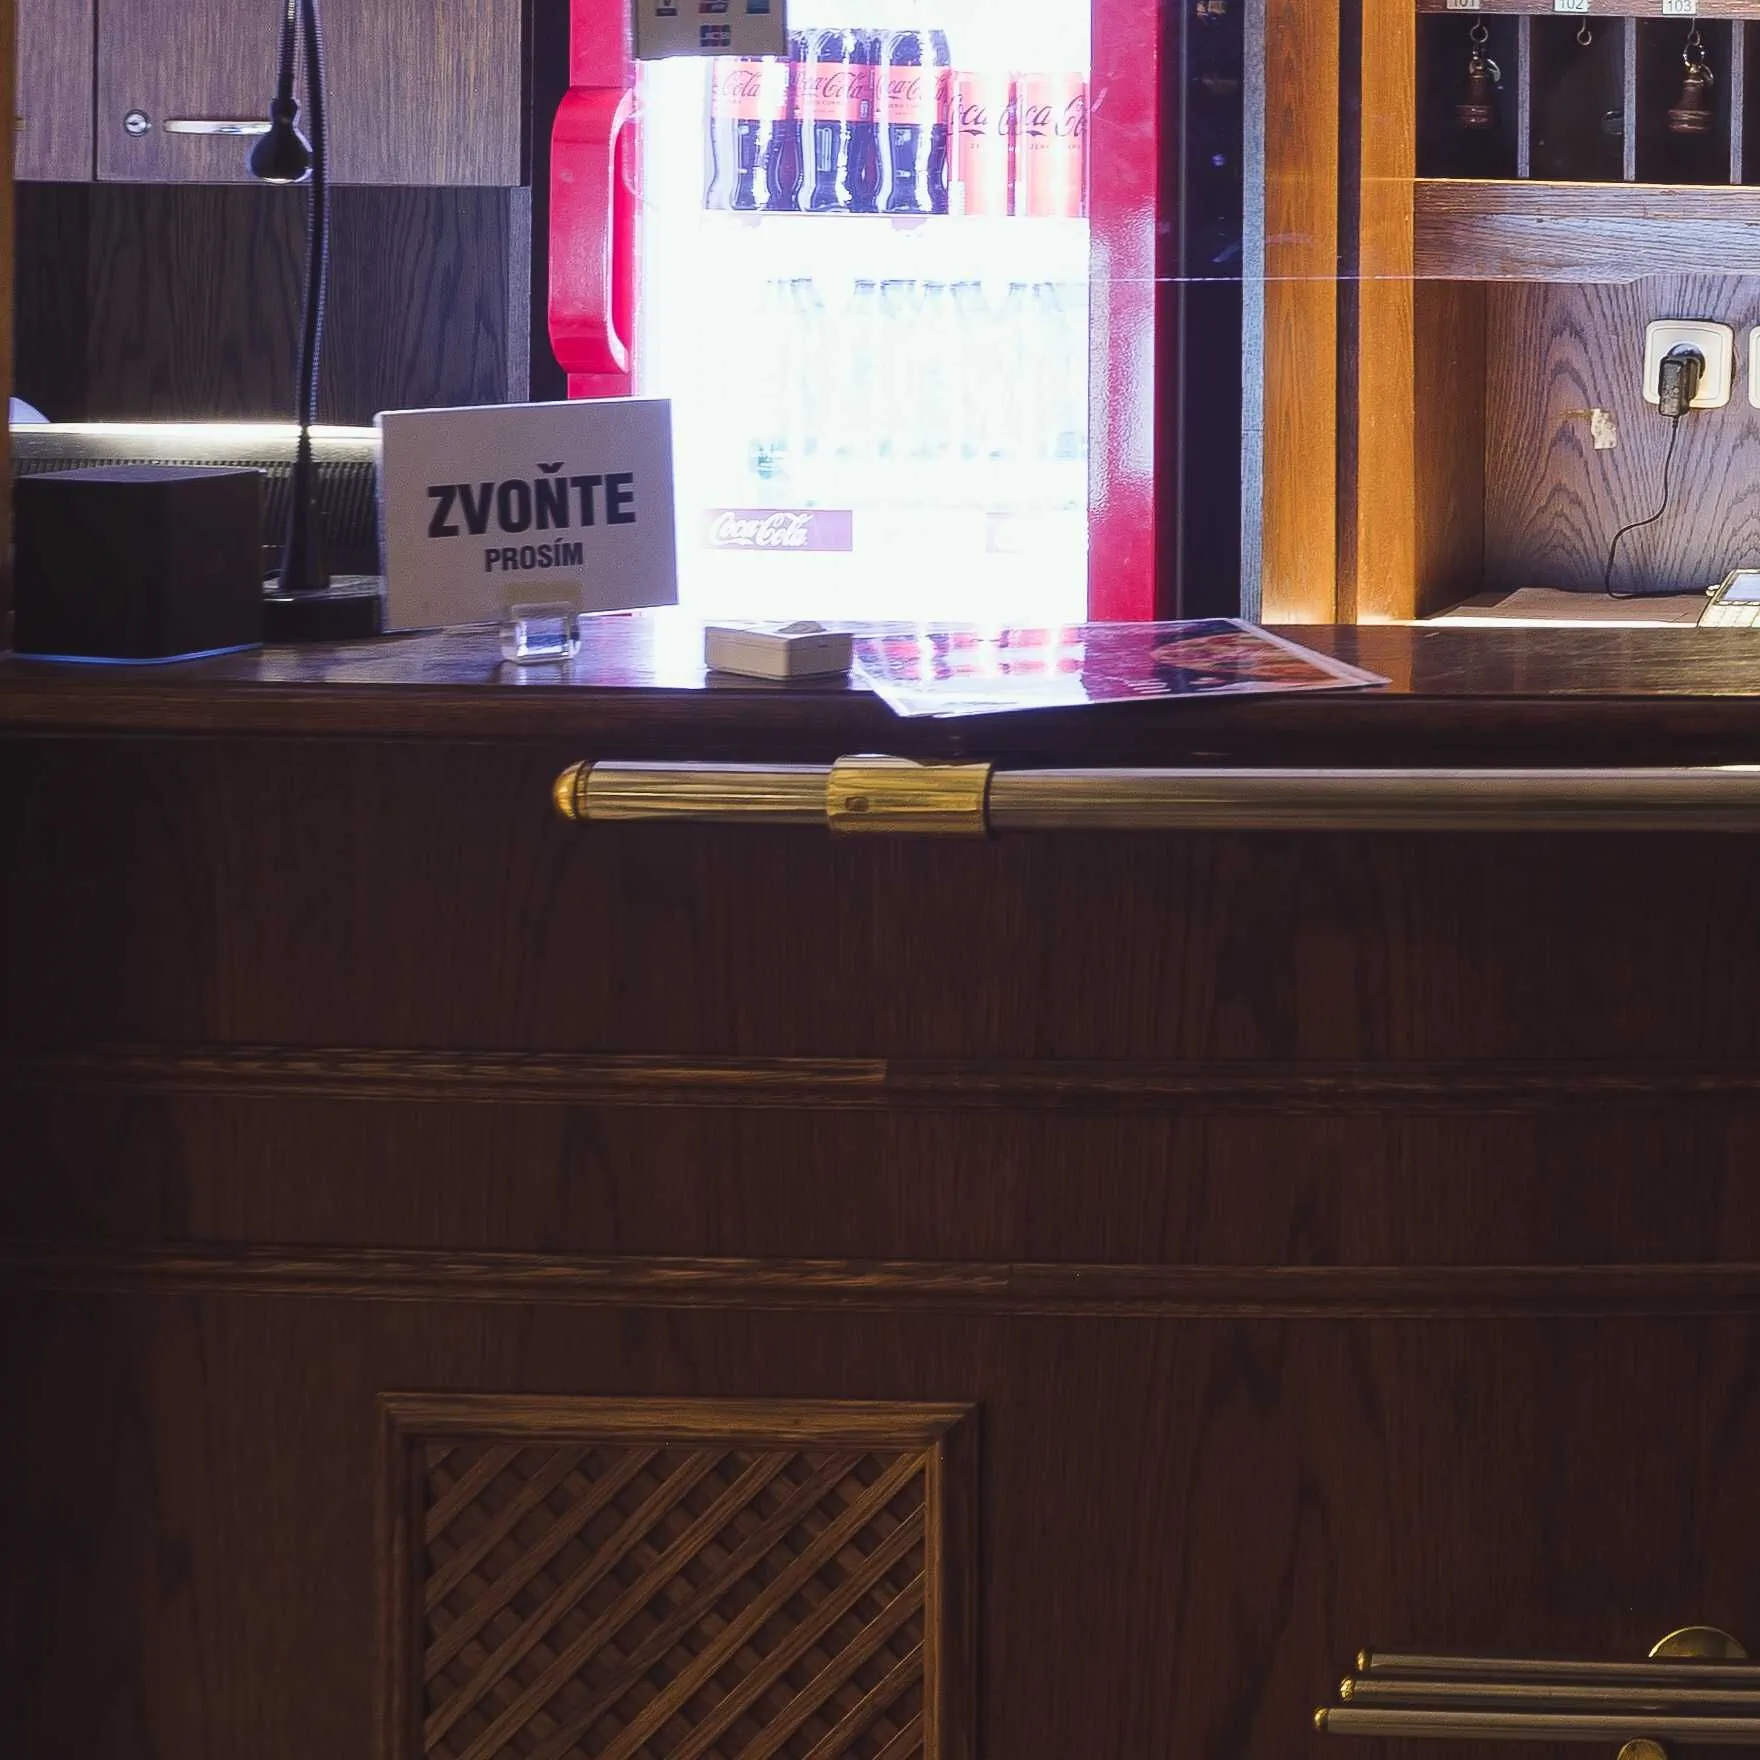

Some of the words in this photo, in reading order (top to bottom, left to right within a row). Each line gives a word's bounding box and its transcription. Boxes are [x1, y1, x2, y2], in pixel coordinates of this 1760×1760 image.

[1667, 0, 1692, 12] 103
[426, 461, 637, 539] ZVOŇTE
[484, 537, 584, 573] PROSÍM
